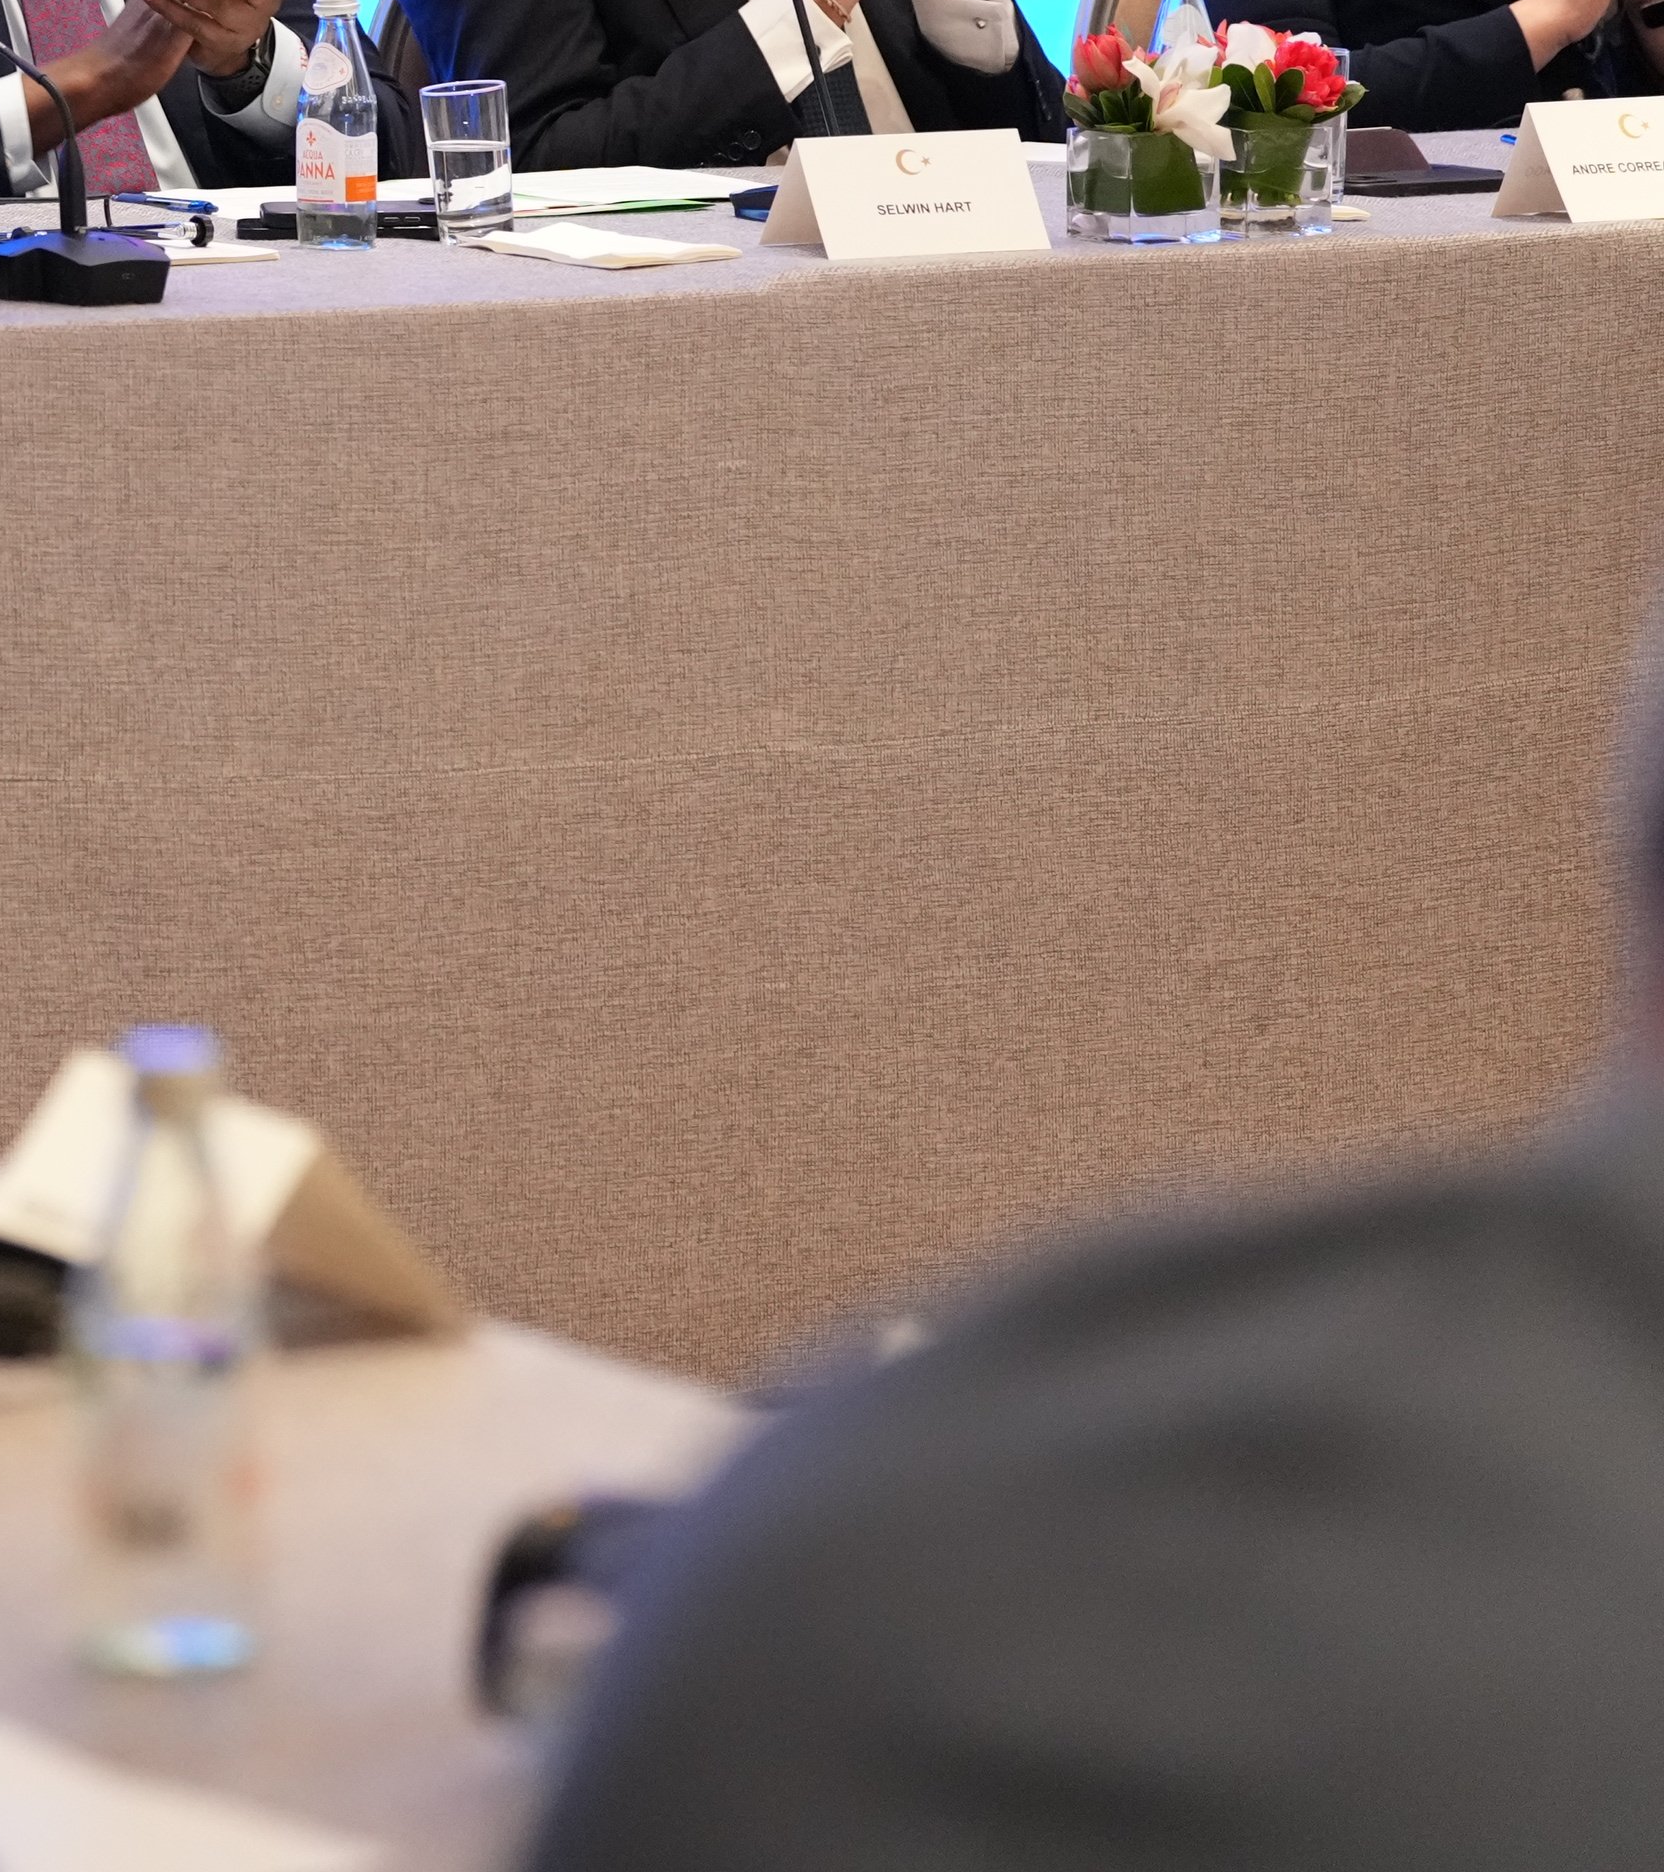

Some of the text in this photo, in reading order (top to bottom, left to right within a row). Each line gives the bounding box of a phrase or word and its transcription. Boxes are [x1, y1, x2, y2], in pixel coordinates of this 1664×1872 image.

[1572, 161, 1664, 175] ANDRE CORRE
[876, 201, 972, 216] SELWIN HART
